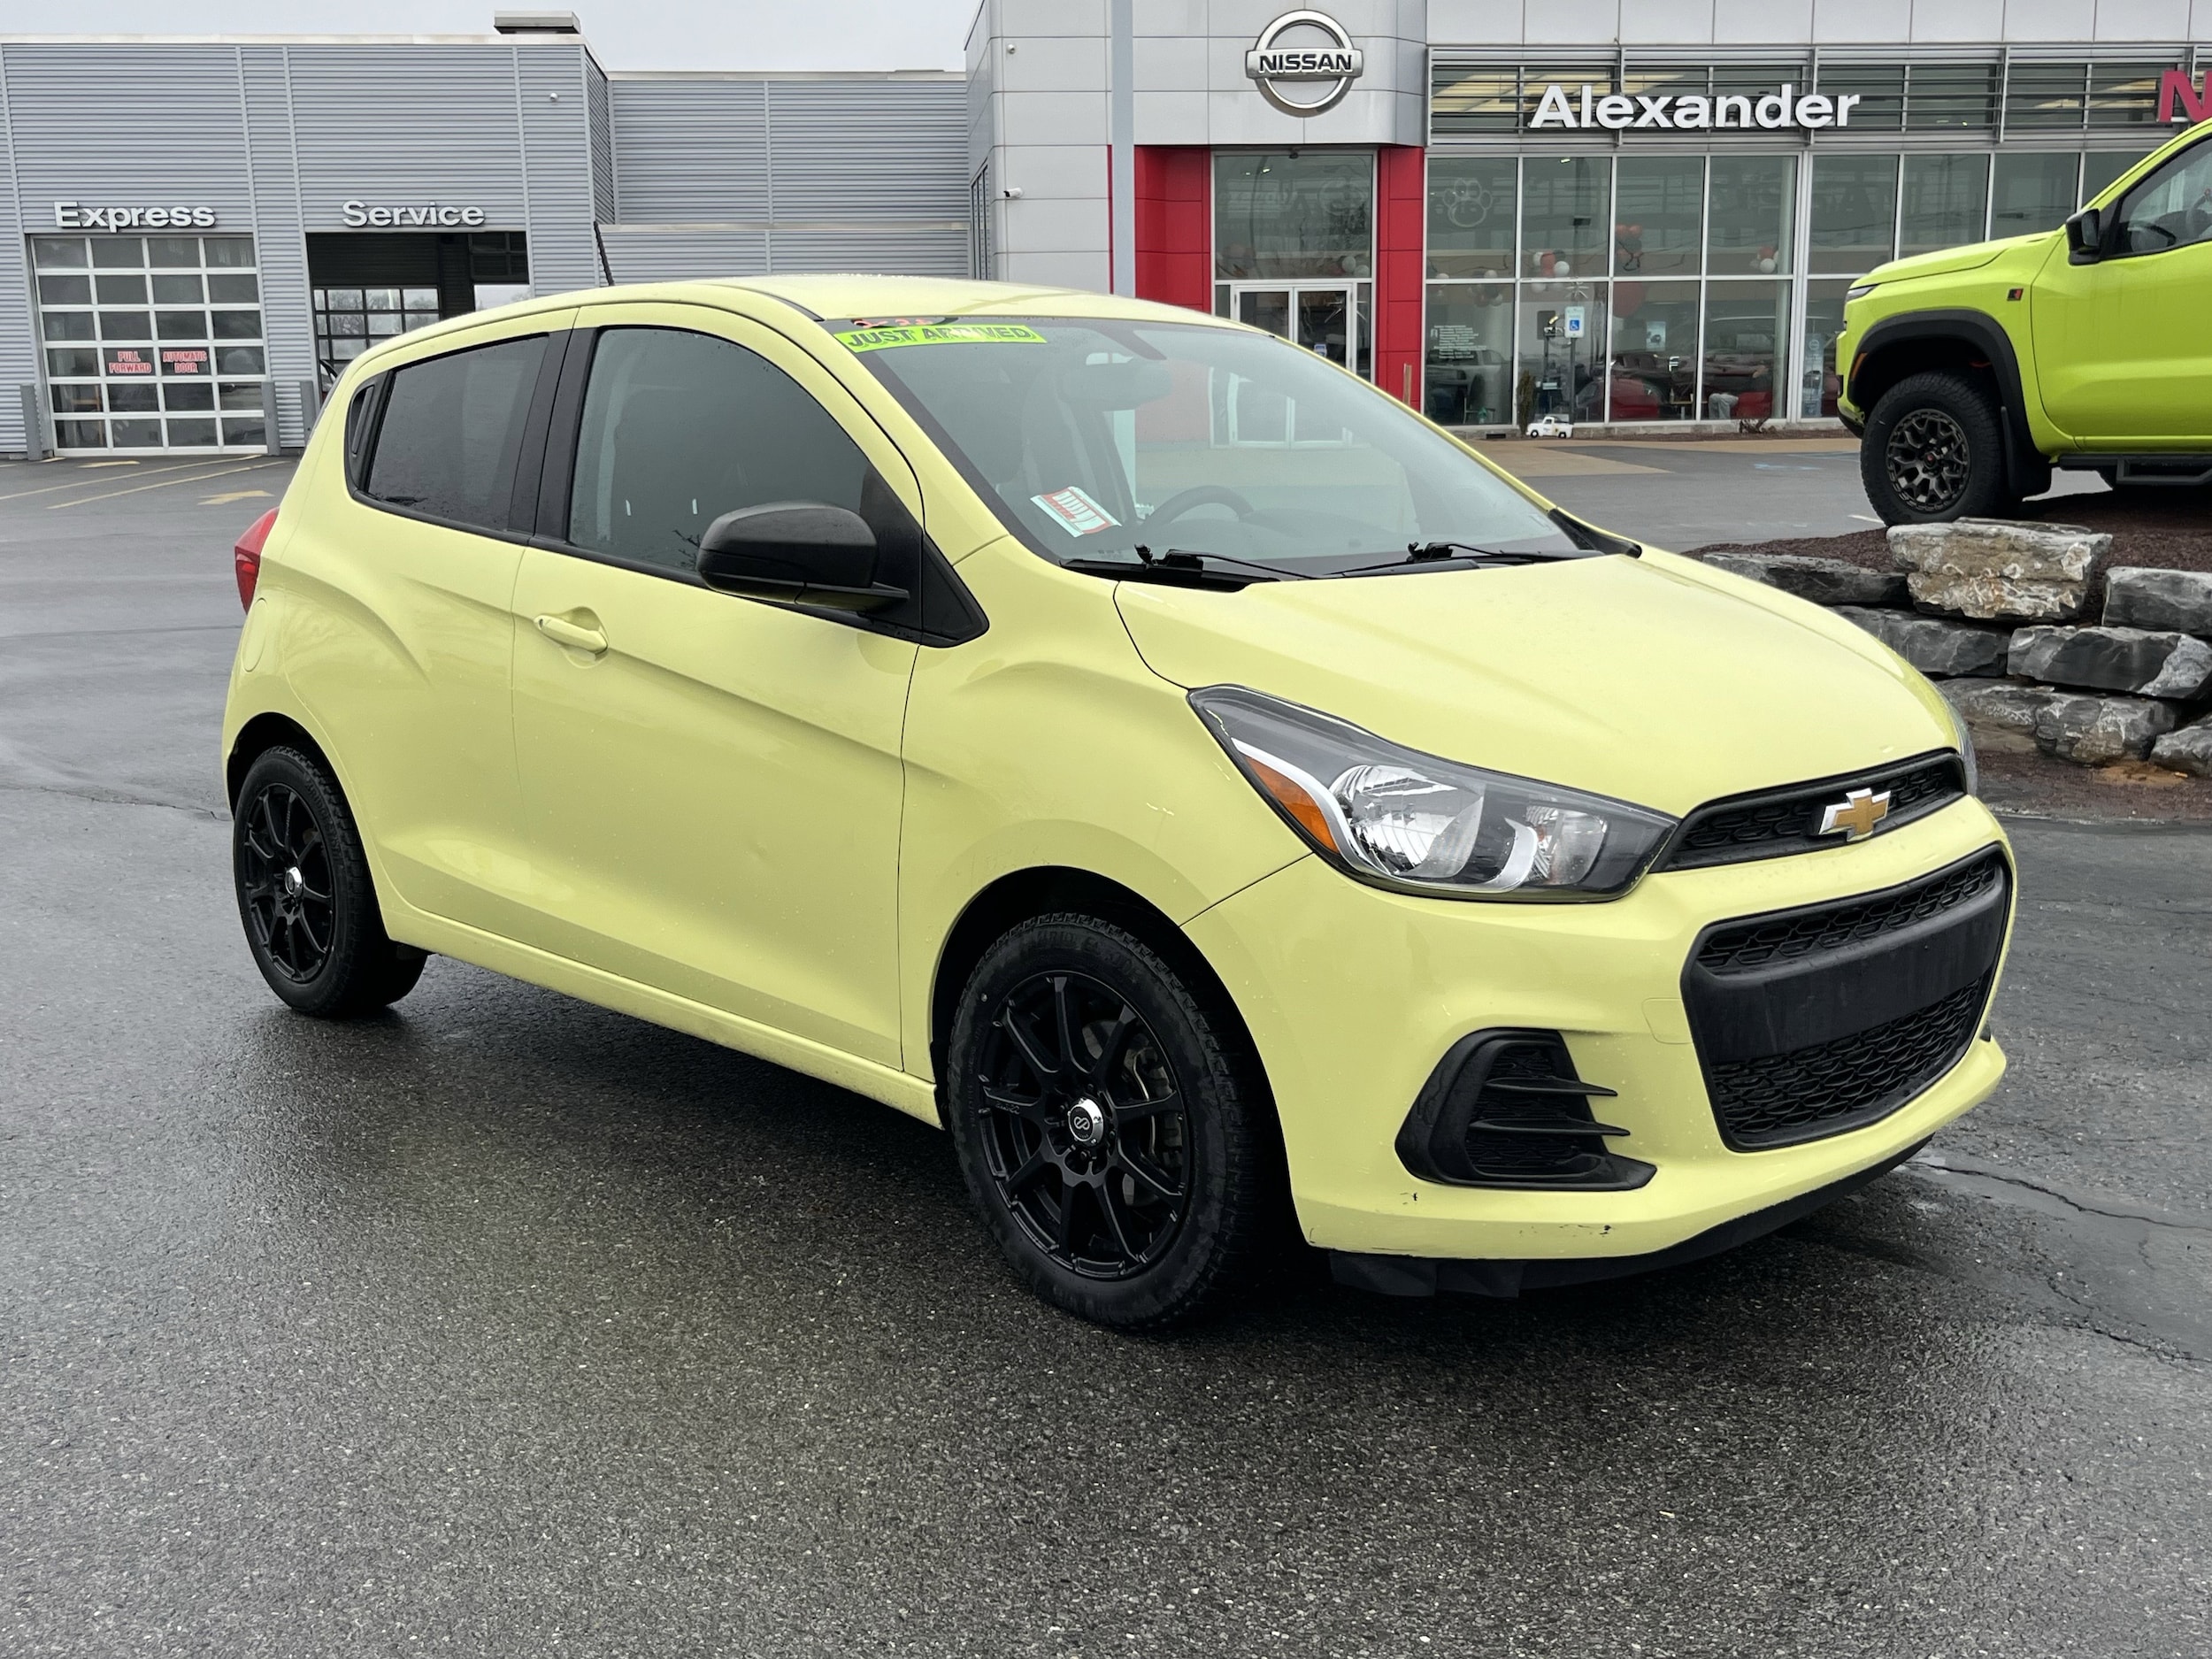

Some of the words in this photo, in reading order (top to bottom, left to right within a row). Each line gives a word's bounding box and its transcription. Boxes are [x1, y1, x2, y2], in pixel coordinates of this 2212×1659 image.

[1259, 54, 1352, 73] NISSAN
[1529, 84, 1860, 128] Alexander
[54, 201, 216, 233] Express
[342, 200, 486, 227] Service
[848, 329, 914, 347] JUST
[118, 351, 141, 362] PULL
[163, 350, 208, 363] AUTOMATIC
[108, 362, 151, 373] FORWARD
[174, 362, 198, 373] DOOR
